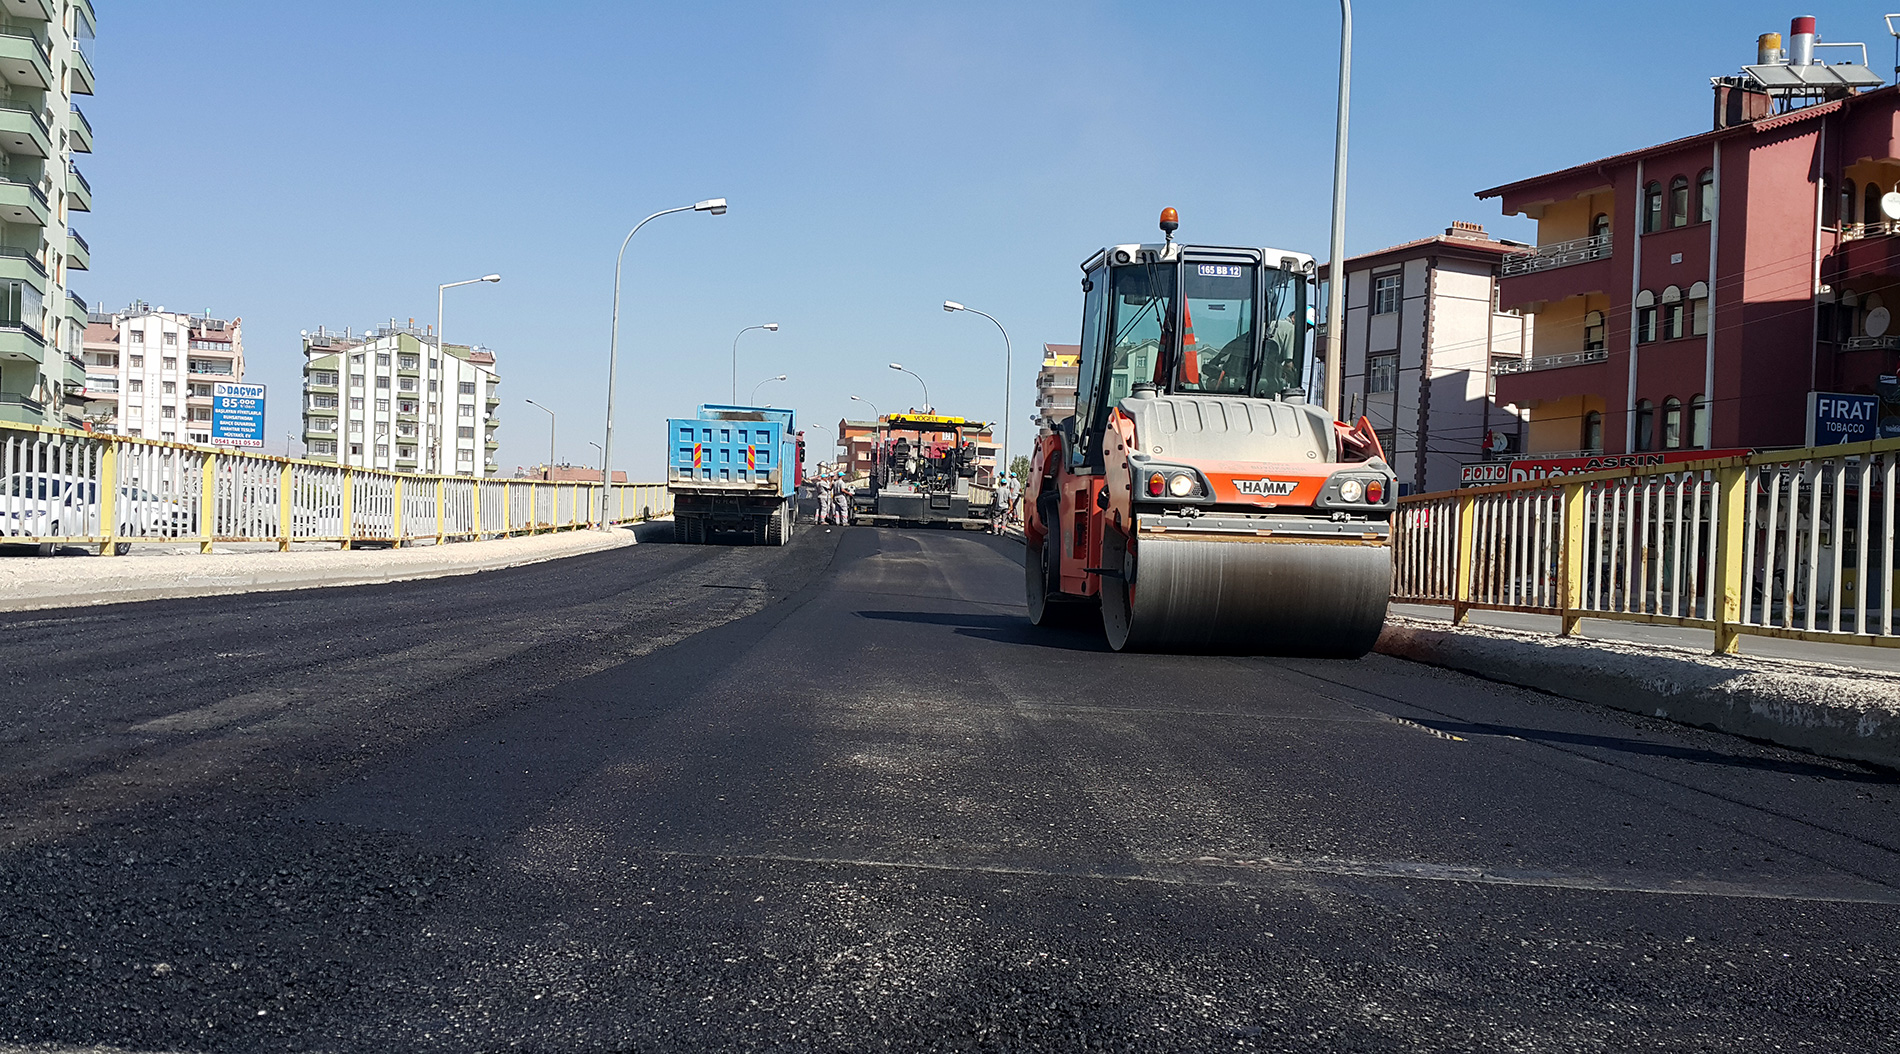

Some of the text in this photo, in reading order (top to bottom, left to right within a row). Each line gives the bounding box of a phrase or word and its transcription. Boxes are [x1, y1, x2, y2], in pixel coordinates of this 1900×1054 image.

[1201, 265, 1239, 275] 165 BB 12
[227, 386, 263, 396] DAÇYAP
[1819, 399, 1875, 420] FIRAT
[1826, 422, 1865, 433] TOBACCO
[1585, 455, 1665, 469] ASRIN
[1462, 467, 1505, 480] FOTO
[1243, 482, 1287, 493] HAMM
